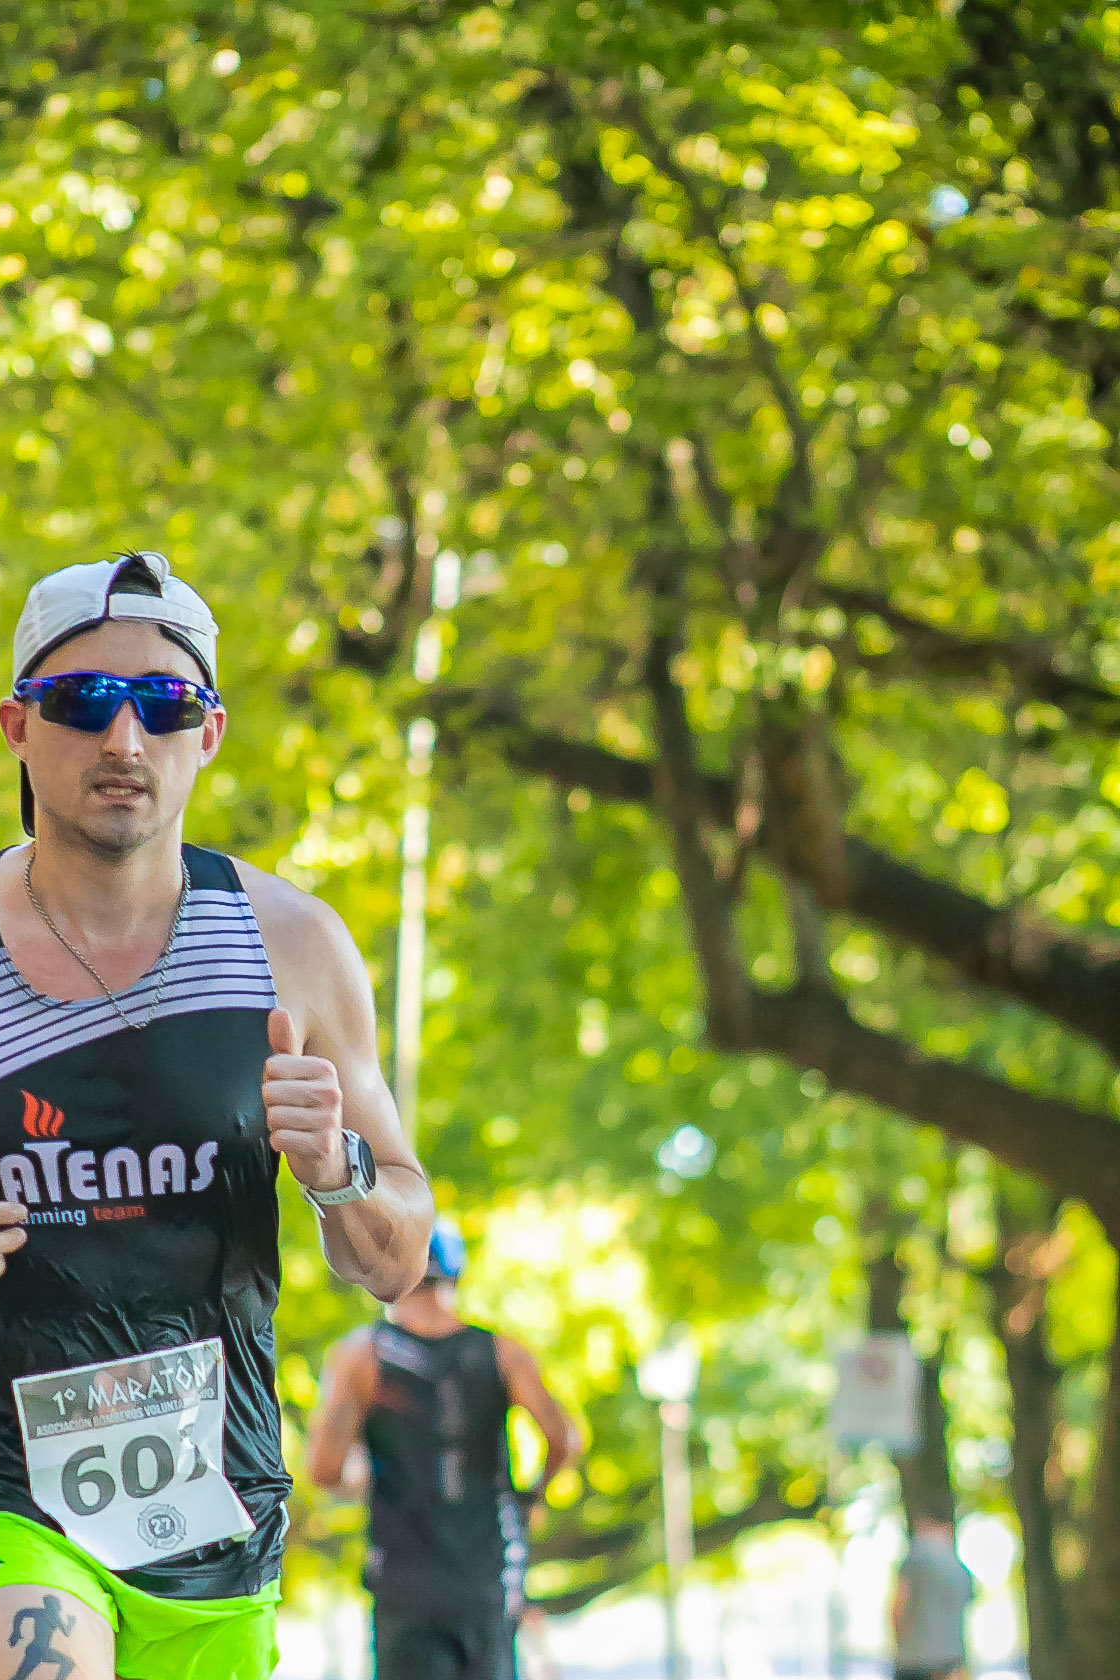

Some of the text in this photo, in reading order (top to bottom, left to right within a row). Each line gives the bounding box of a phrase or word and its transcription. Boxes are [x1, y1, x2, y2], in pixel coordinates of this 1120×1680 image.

[20, 1205, 146, 1226] nning team
[87, 1356, 207, 1411] MARATÓN
